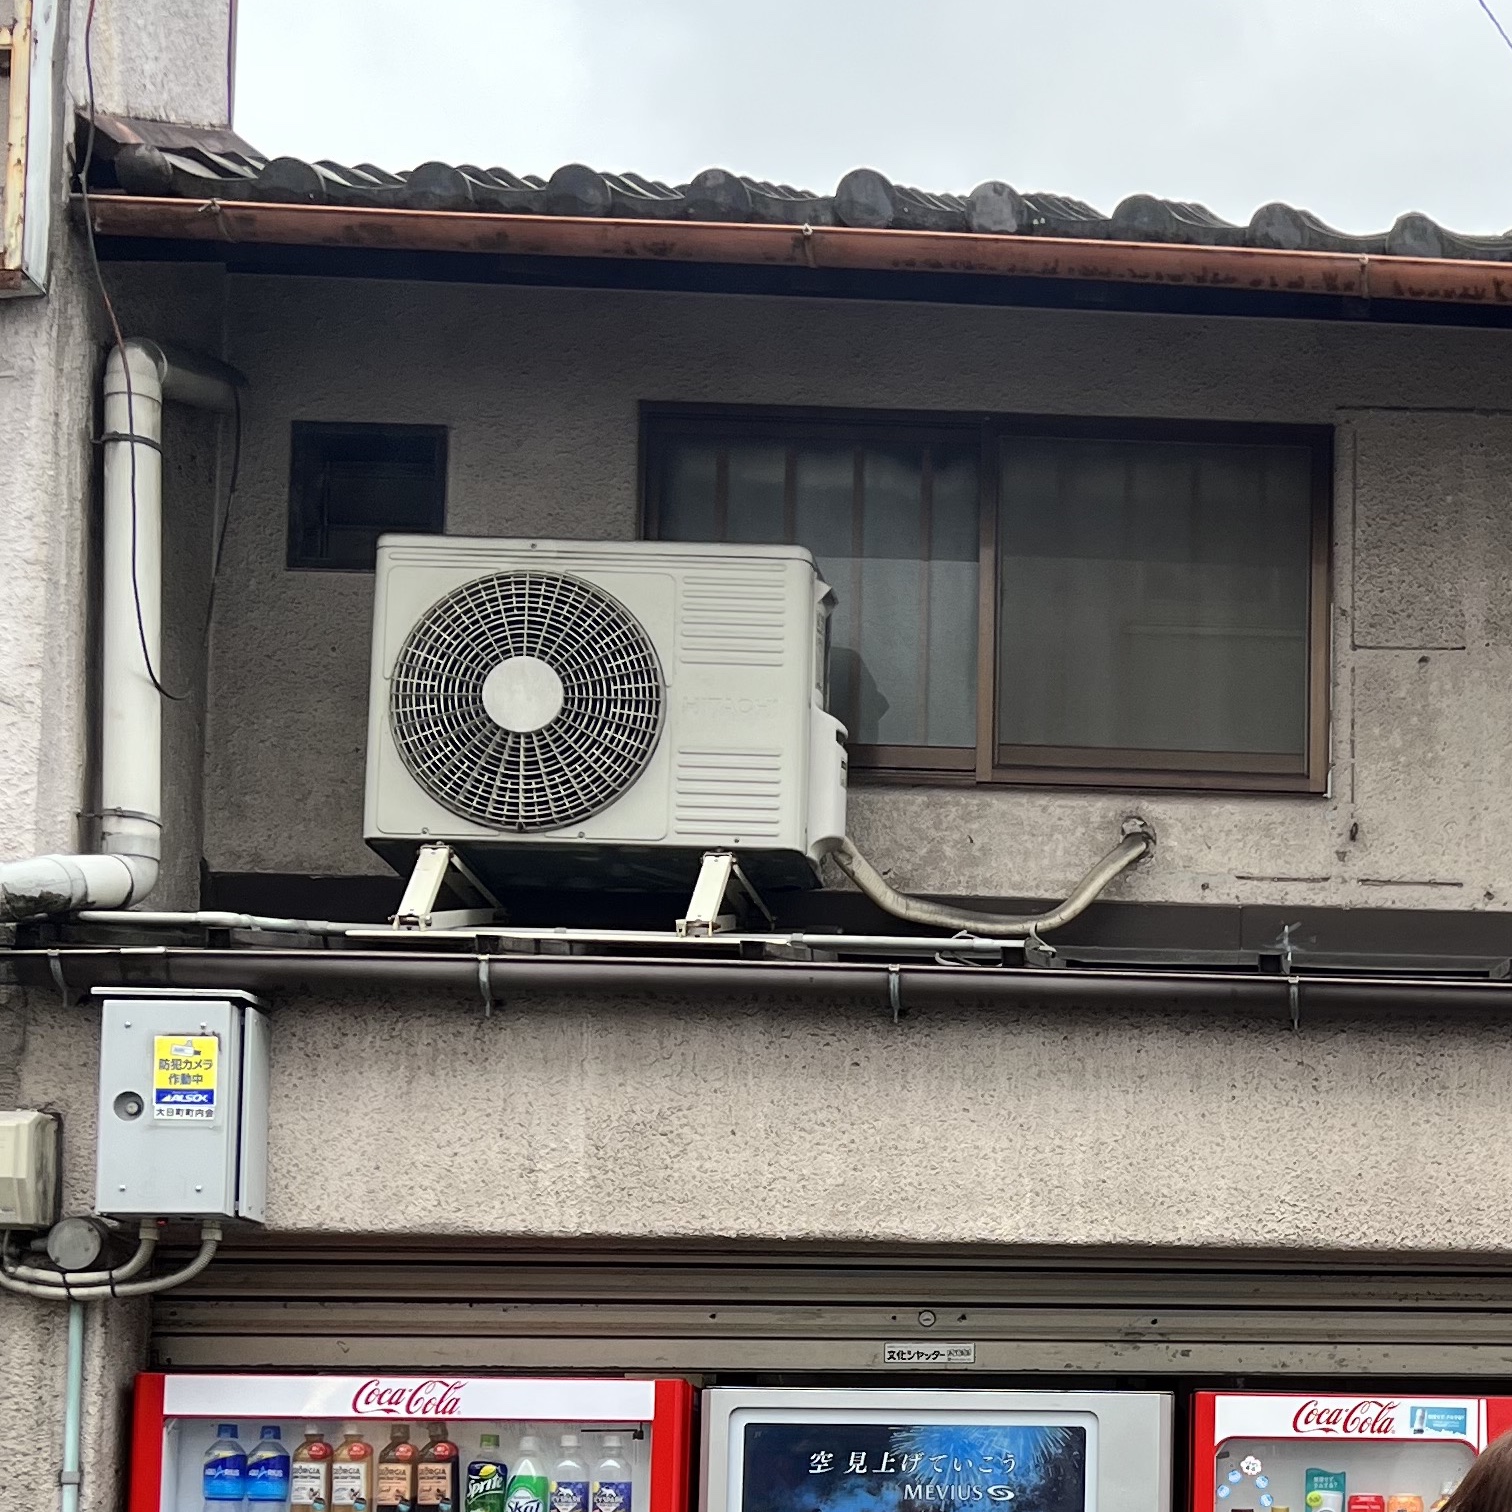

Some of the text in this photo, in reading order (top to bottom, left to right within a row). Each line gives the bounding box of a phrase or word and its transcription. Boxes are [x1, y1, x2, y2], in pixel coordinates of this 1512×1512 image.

[682, 696, 779, 716] HITACHI
[158, 1058, 213, 1071] 防犯カメラ
[168, 1073, 203, 1085] 作動中
[171, 1094, 208, 1102] ALSOK
[887, 1350, 945, 1361] 文化シャッター
[352, 1379, 468, 1414] Coca-Cola
[1292, 1400, 1400, 1434] Coca-Cola
[808, 1450, 1017, 1475] 空 見上げていこう
[467, 1473, 503, 1499] Sprite
[903, 1484, 982, 1500] MEVIUS
